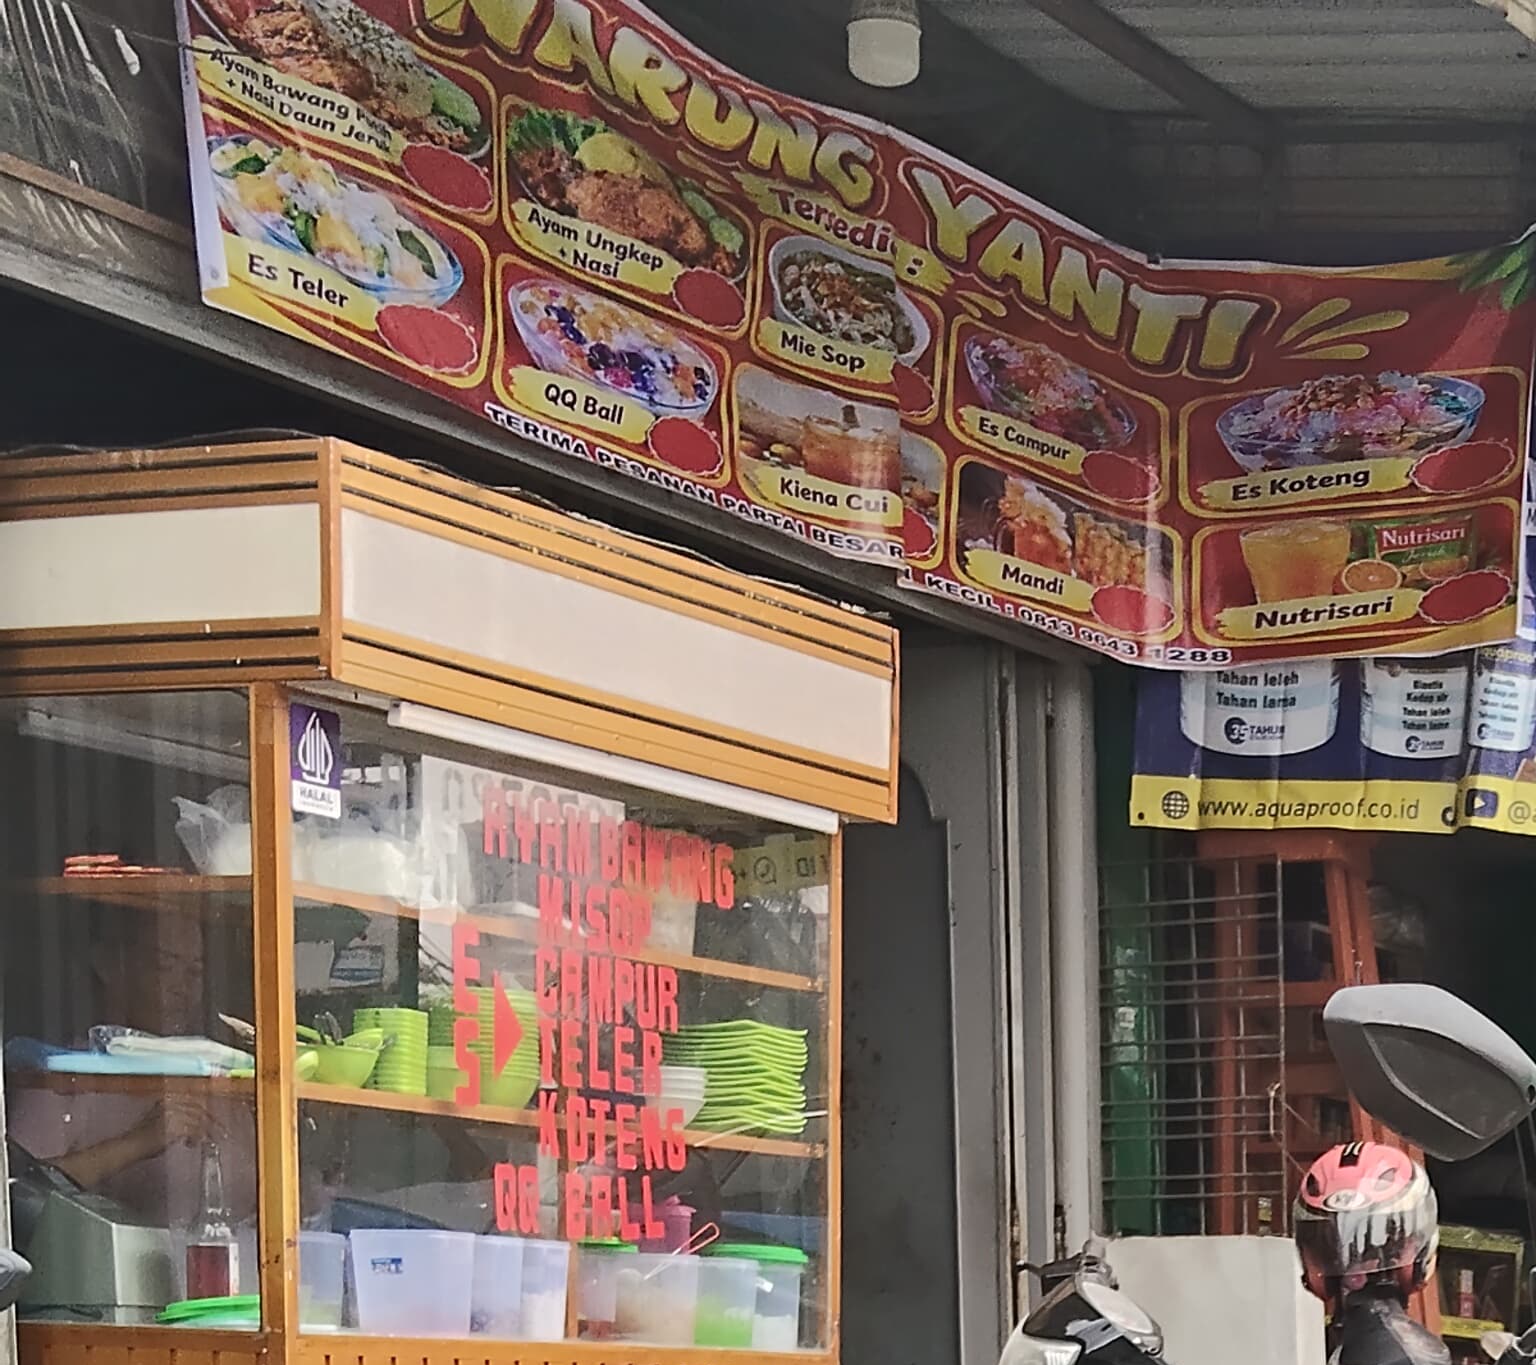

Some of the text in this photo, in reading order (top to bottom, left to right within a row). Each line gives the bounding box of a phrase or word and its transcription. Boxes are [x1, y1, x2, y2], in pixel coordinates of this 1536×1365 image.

[210, 48, 260, 84] Ayam
[262, 73, 350, 120] Bawang
[241, 80, 275, 111] Nasi
[278, 102, 336, 133] Daun
[528, 208, 664, 272] Ayam Ungkep
[247, 253, 349, 309] Es Teler
[572, 252, 620, 279] Nasi
[911, 166, 1261, 371] YANTI
[780, 330, 866, 375] Mie Sop
[543, 383, 624, 425] QQ Ball
[977, 417, 1071, 461] Es Campur
[485, 404, 904, 559] TERIMA PESANAN PARTAI BESAR
[846, 493, 889, 514] Cui
[1231, 469, 1371, 502] Es Koteng
[1382, 527, 1466, 548] Nutrisari
[1001, 563, 1065, 596] Mandi
[925, 576, 1001, 610] KECIL
[1019, 608, 1074, 637] 0813
[1080, 629, 1137, 656] 9643
[1153, 648, 1231, 663] 1288
[1254, 596, 1394, 631] Nutrisari
[1215, 691, 1258, 709] Tahan
[299, 786, 334, 804] HALAL
[1198, 797, 1420, 822] www.aquaproof.co.id
[483, 788, 591, 877] AYAM
[603, 815, 735, 911] BAWANG
[535, 945, 680, 1034] CAMPUR
[537, 1016, 663, 1098] TELER
[539, 1090, 688, 1172] KOTENG
[493, 1162, 665, 1241] QQ BALL
